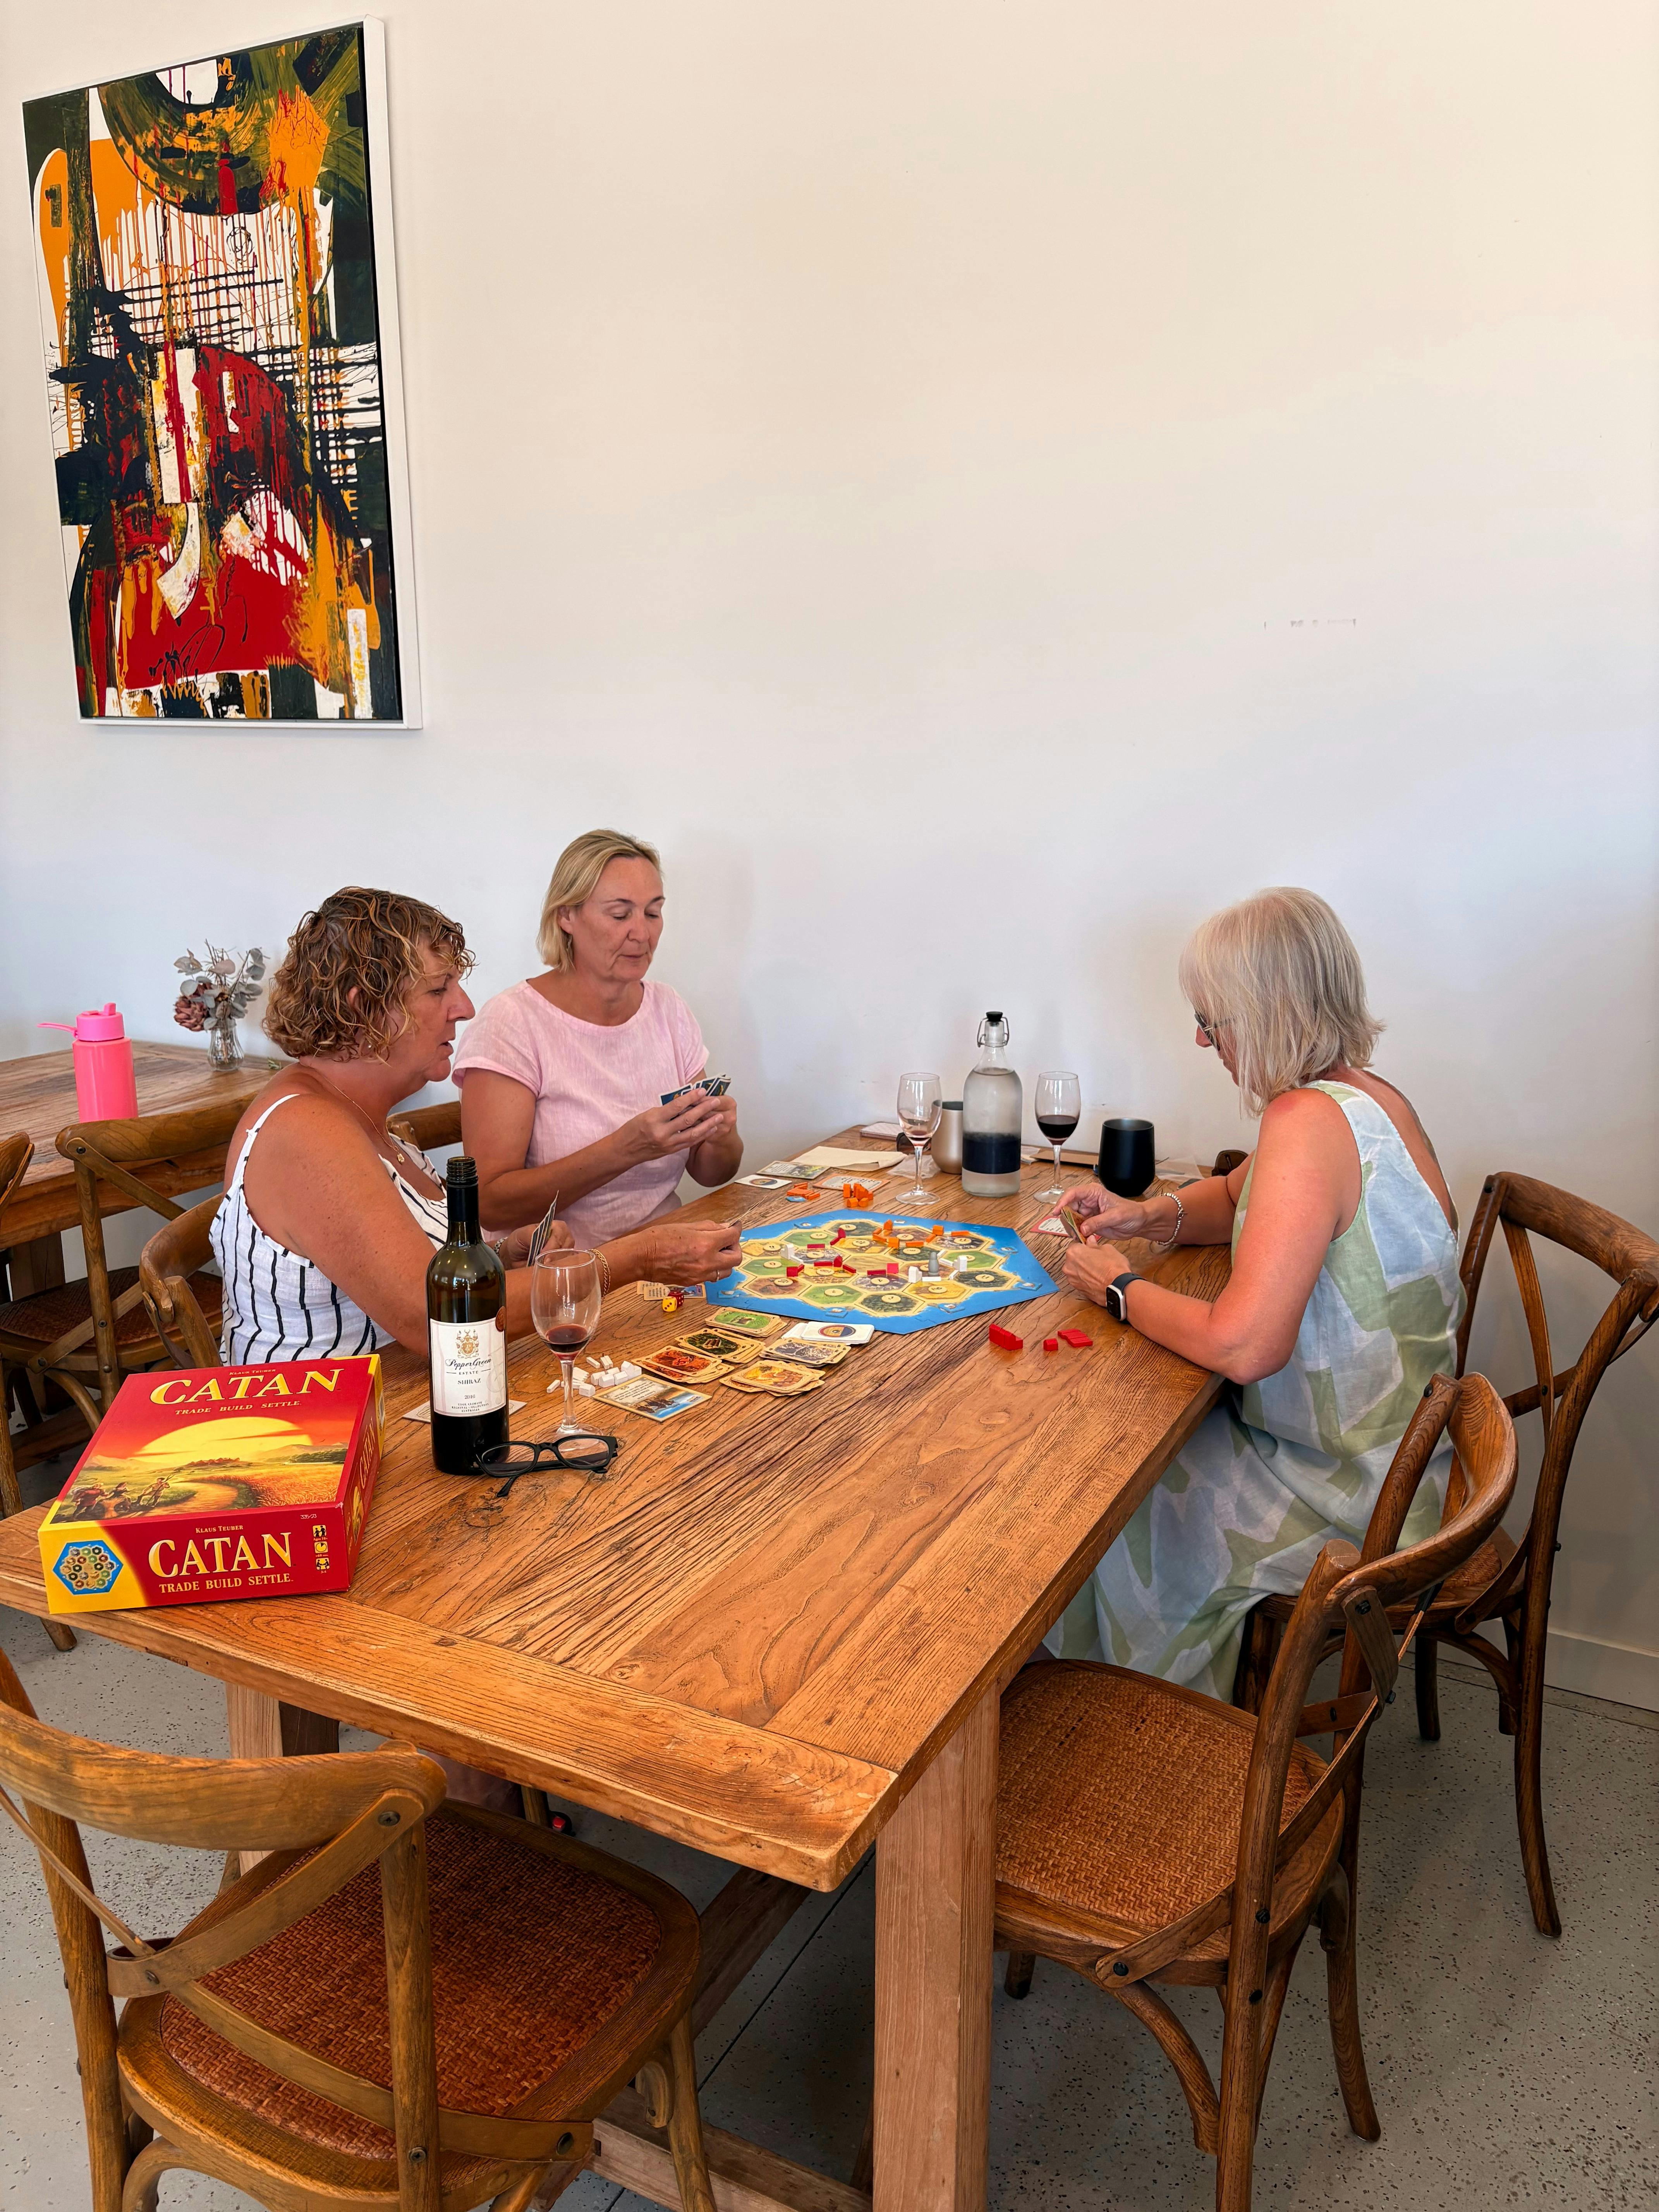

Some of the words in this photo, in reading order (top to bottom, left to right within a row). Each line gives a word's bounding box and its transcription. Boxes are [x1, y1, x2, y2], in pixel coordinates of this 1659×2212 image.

[149, 1368, 345, 1405] CATAN
[175, 1407, 211, 1415] TRADE
[219, 1404, 253, 1412] BUILD
[261, 1400, 300, 1408] SETTLE
[148, 1532, 292, 1578] CATAN
[159, 1581, 199, 1593] TRADE
[206, 1577, 242, 1590] BUILD
[248, 1573, 291, 1586] SETTLE
